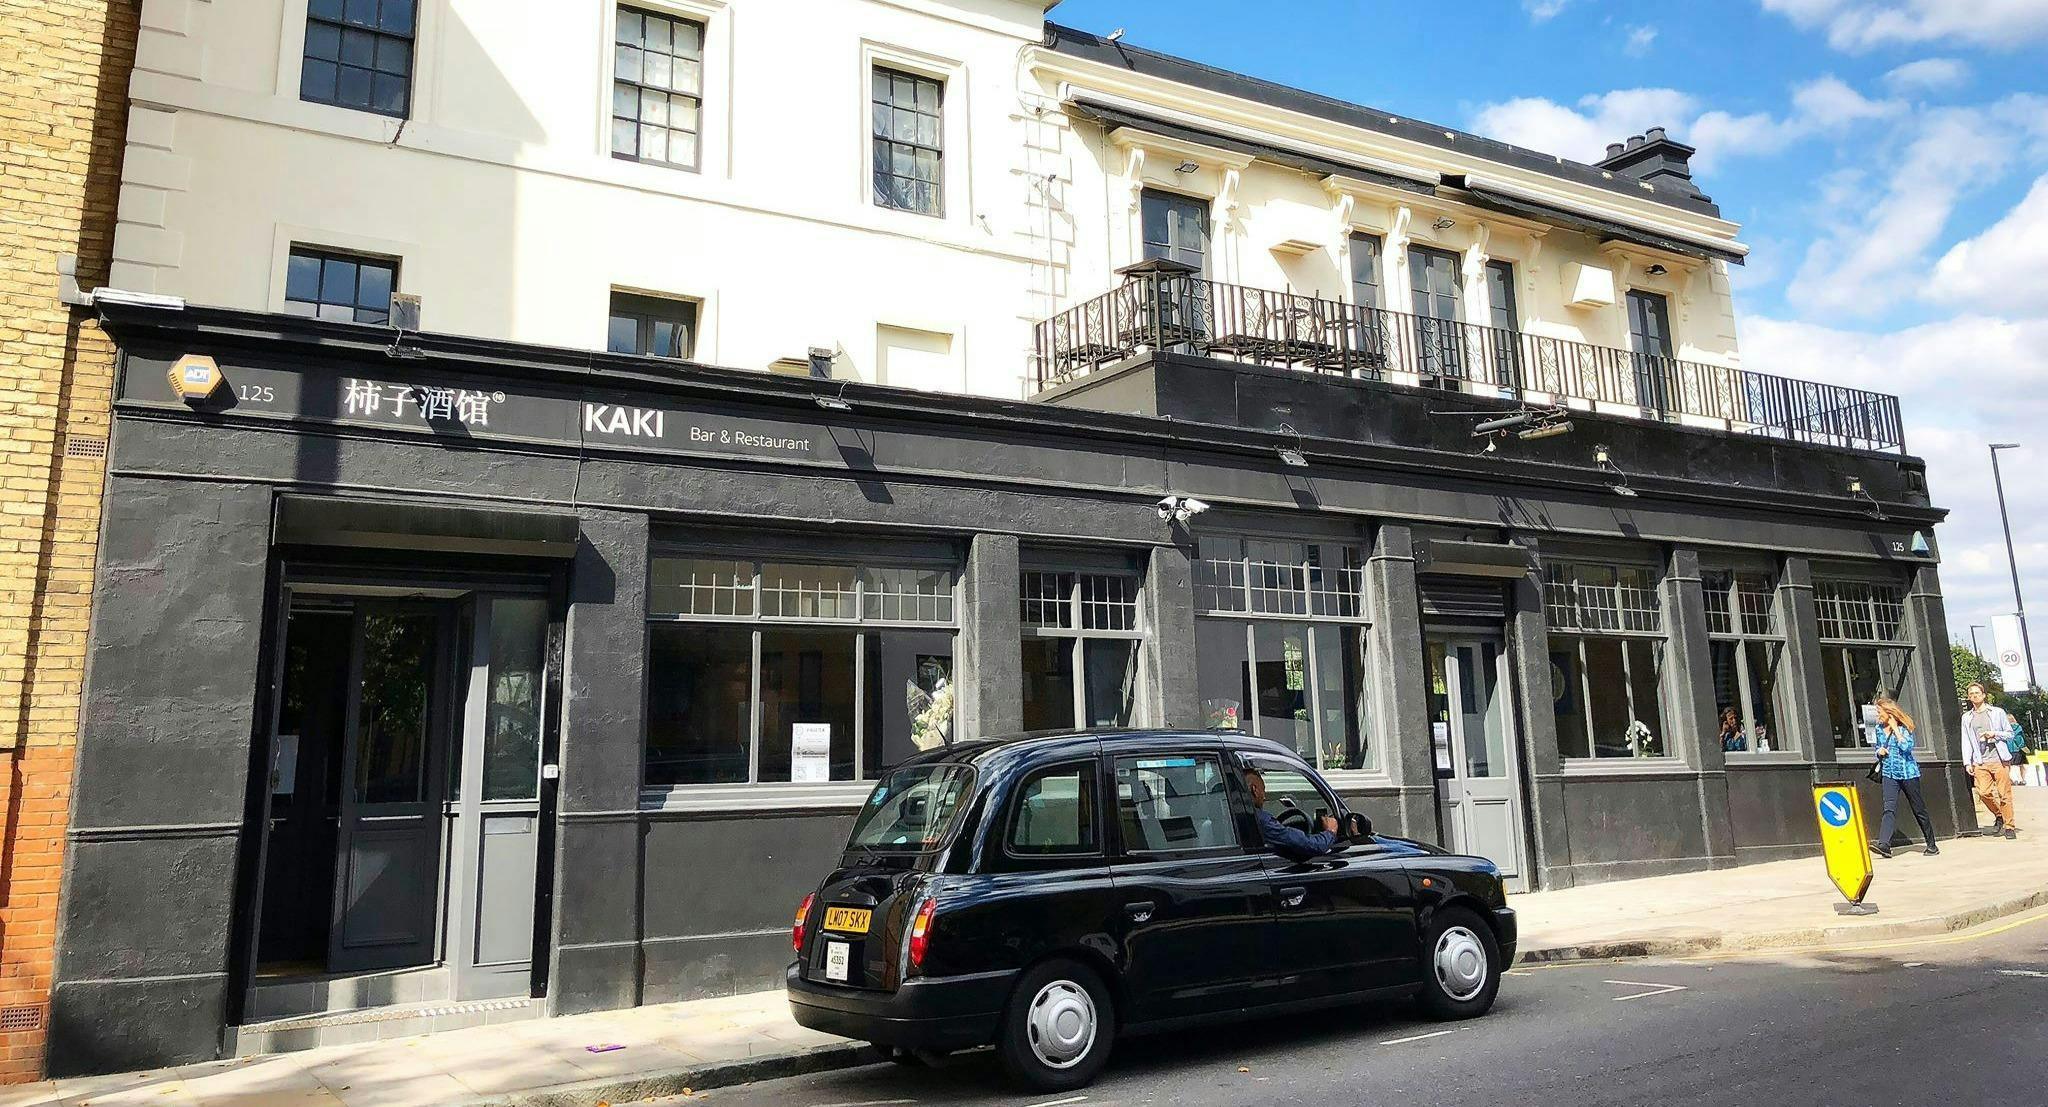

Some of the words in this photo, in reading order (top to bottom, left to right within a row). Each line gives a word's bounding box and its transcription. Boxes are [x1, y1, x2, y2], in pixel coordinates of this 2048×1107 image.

[186, 369, 209, 380] ADT
[239, 385, 275, 402] 125
[344, 379, 491, 426] 柿子酒馆
[585, 403, 664, 438] KAKI
[690, 426, 716, 443] Bar
[720, 430, 731, 444] &
[735, 431, 810, 451] Restaurant
[1892, 542, 1904, 552] 125
[2004, 653, 2017, 663] 20
[849, 911, 868, 929] SKX
